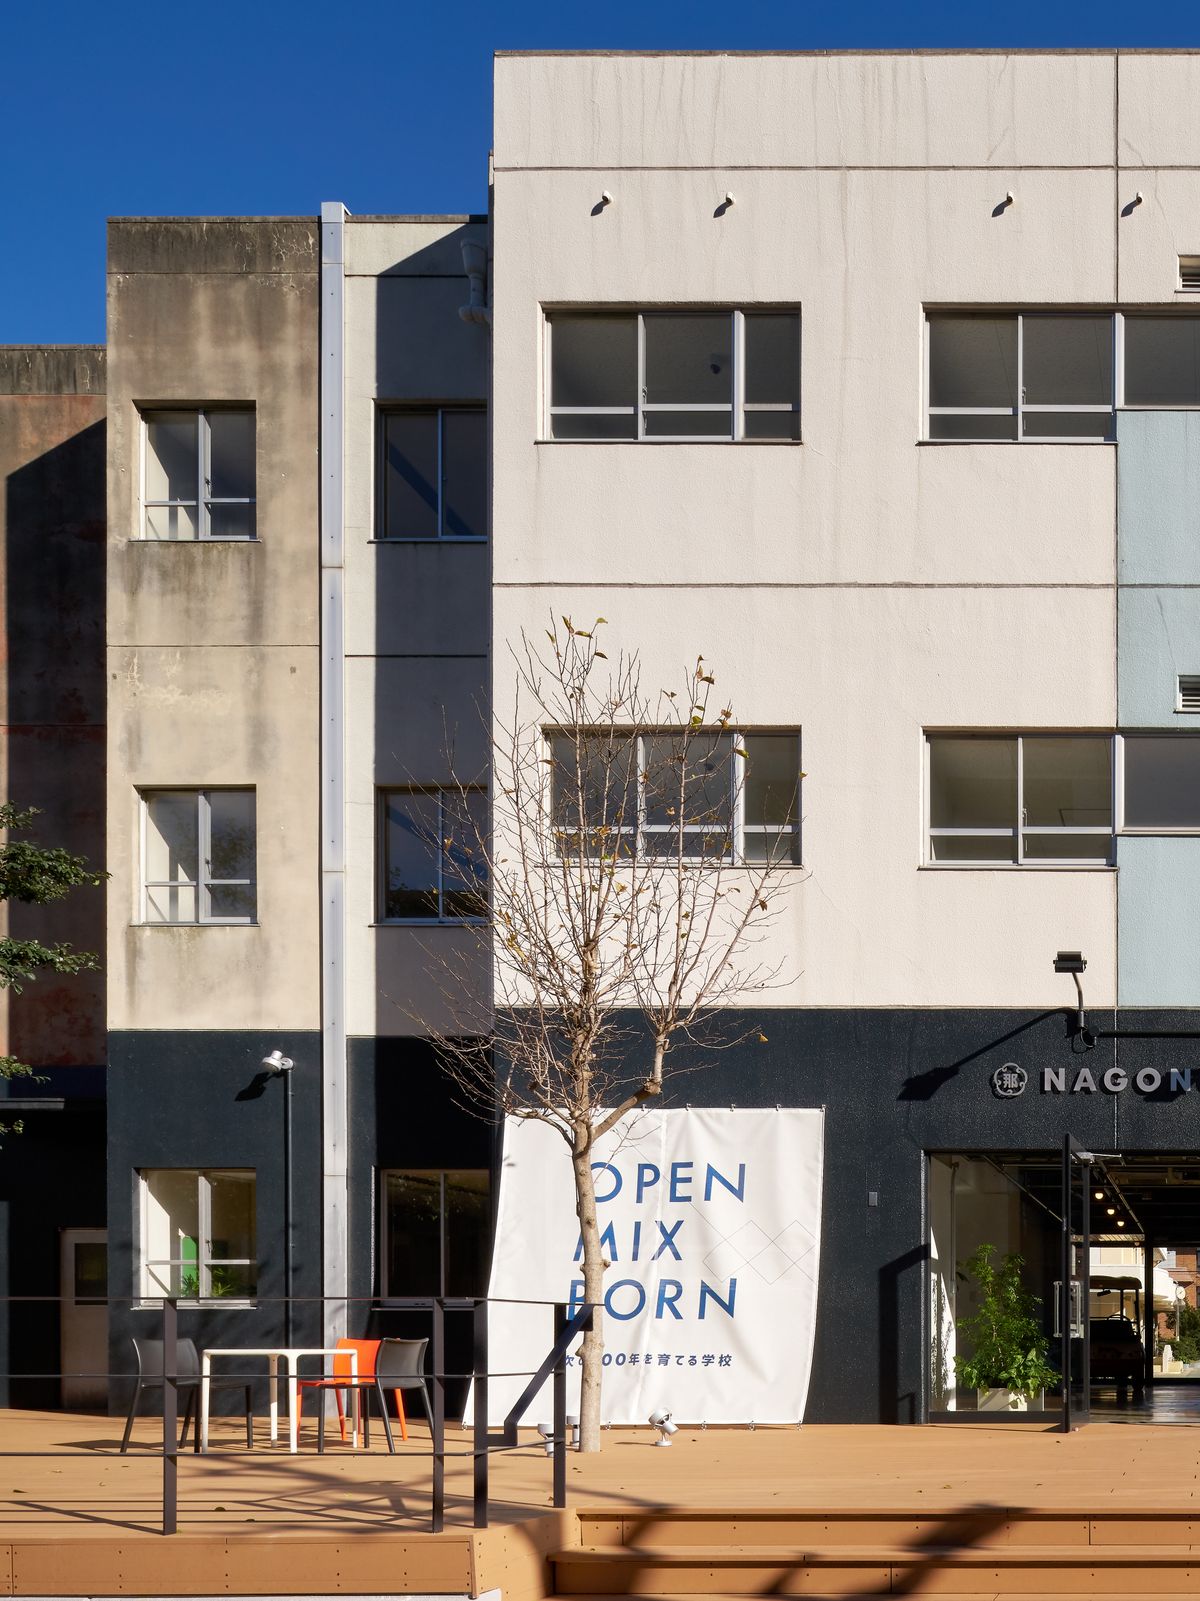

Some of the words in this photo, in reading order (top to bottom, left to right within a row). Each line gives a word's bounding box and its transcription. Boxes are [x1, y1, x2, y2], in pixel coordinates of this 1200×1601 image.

[590, 1161, 746, 1204] OPEN
[572, 1220, 685, 1262] MIX
[565, 1353, 732, 1367] 次00年を育てる学校
